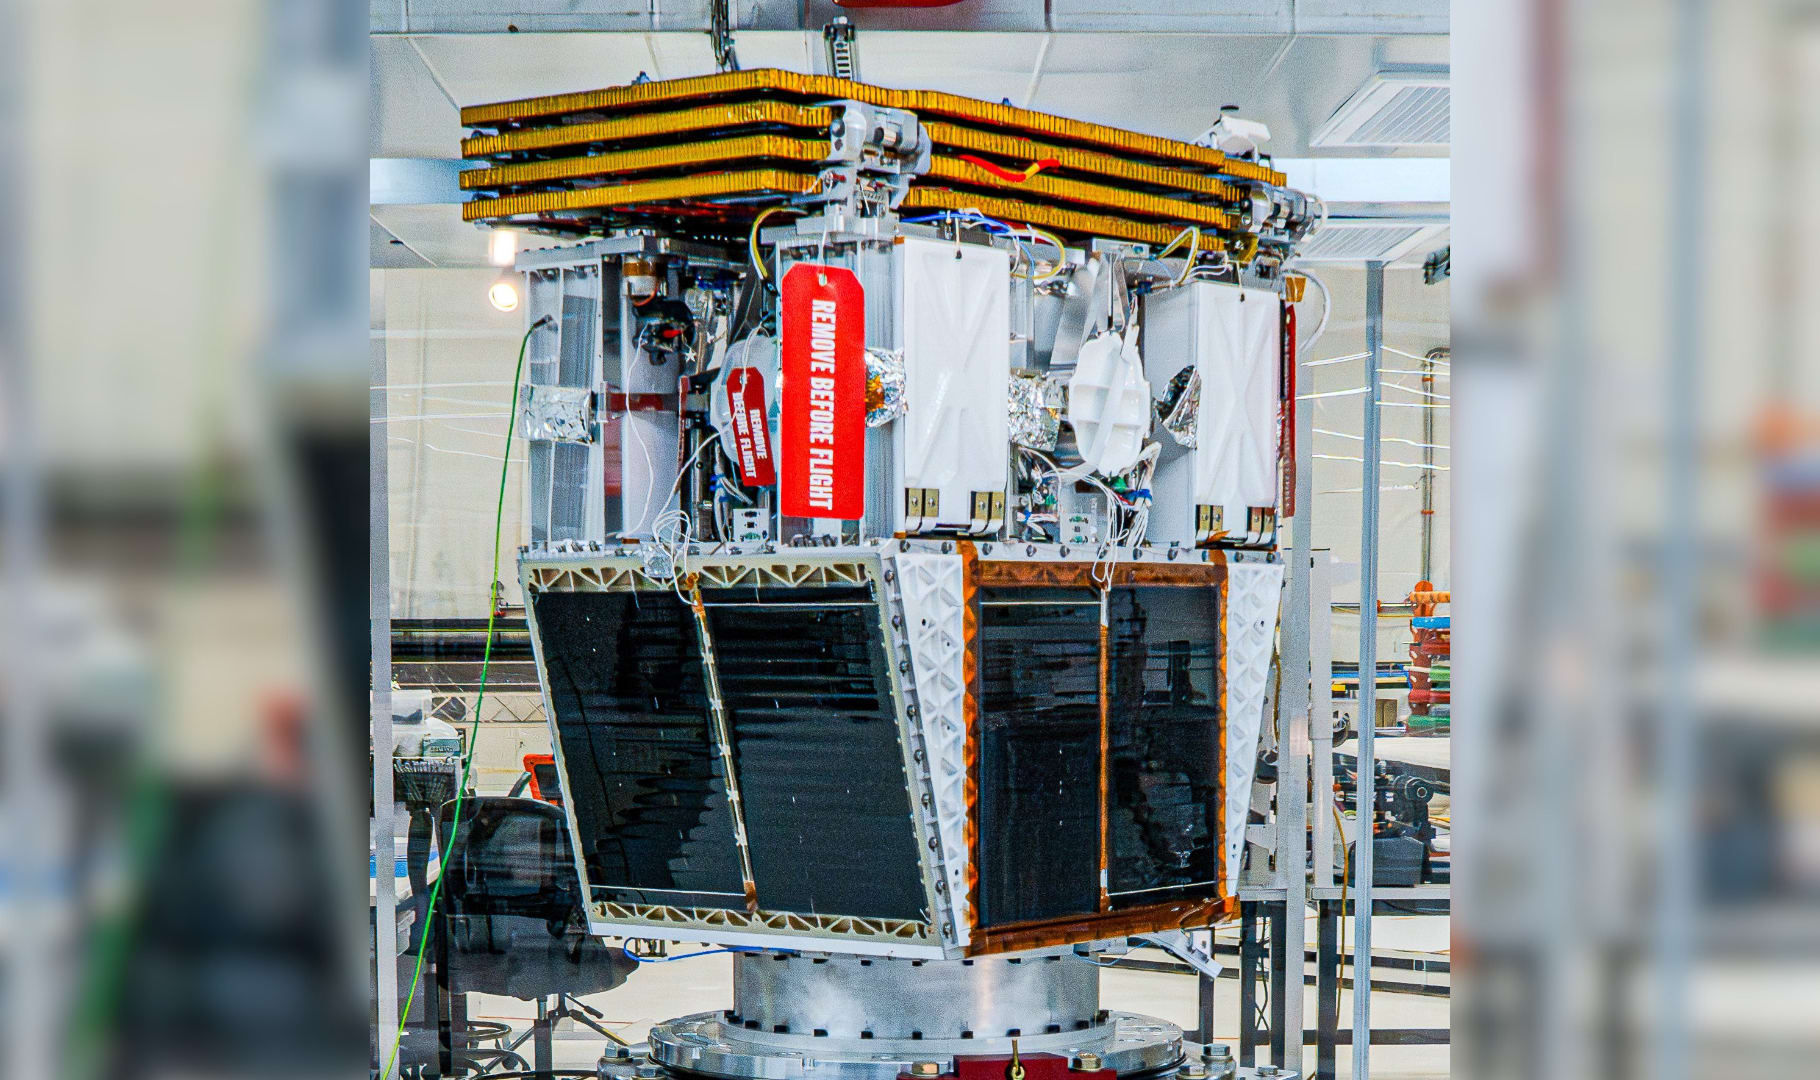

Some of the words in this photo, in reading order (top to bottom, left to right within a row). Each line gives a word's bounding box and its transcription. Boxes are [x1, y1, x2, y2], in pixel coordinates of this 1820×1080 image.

[811, 299, 836, 374] REMOVE
[750, 409, 767, 459] REMOVE
[810, 377, 834, 444] BEFORE
[740, 438, 756, 478] FLIGHT
[809, 448, 833, 510] FLIGHT
